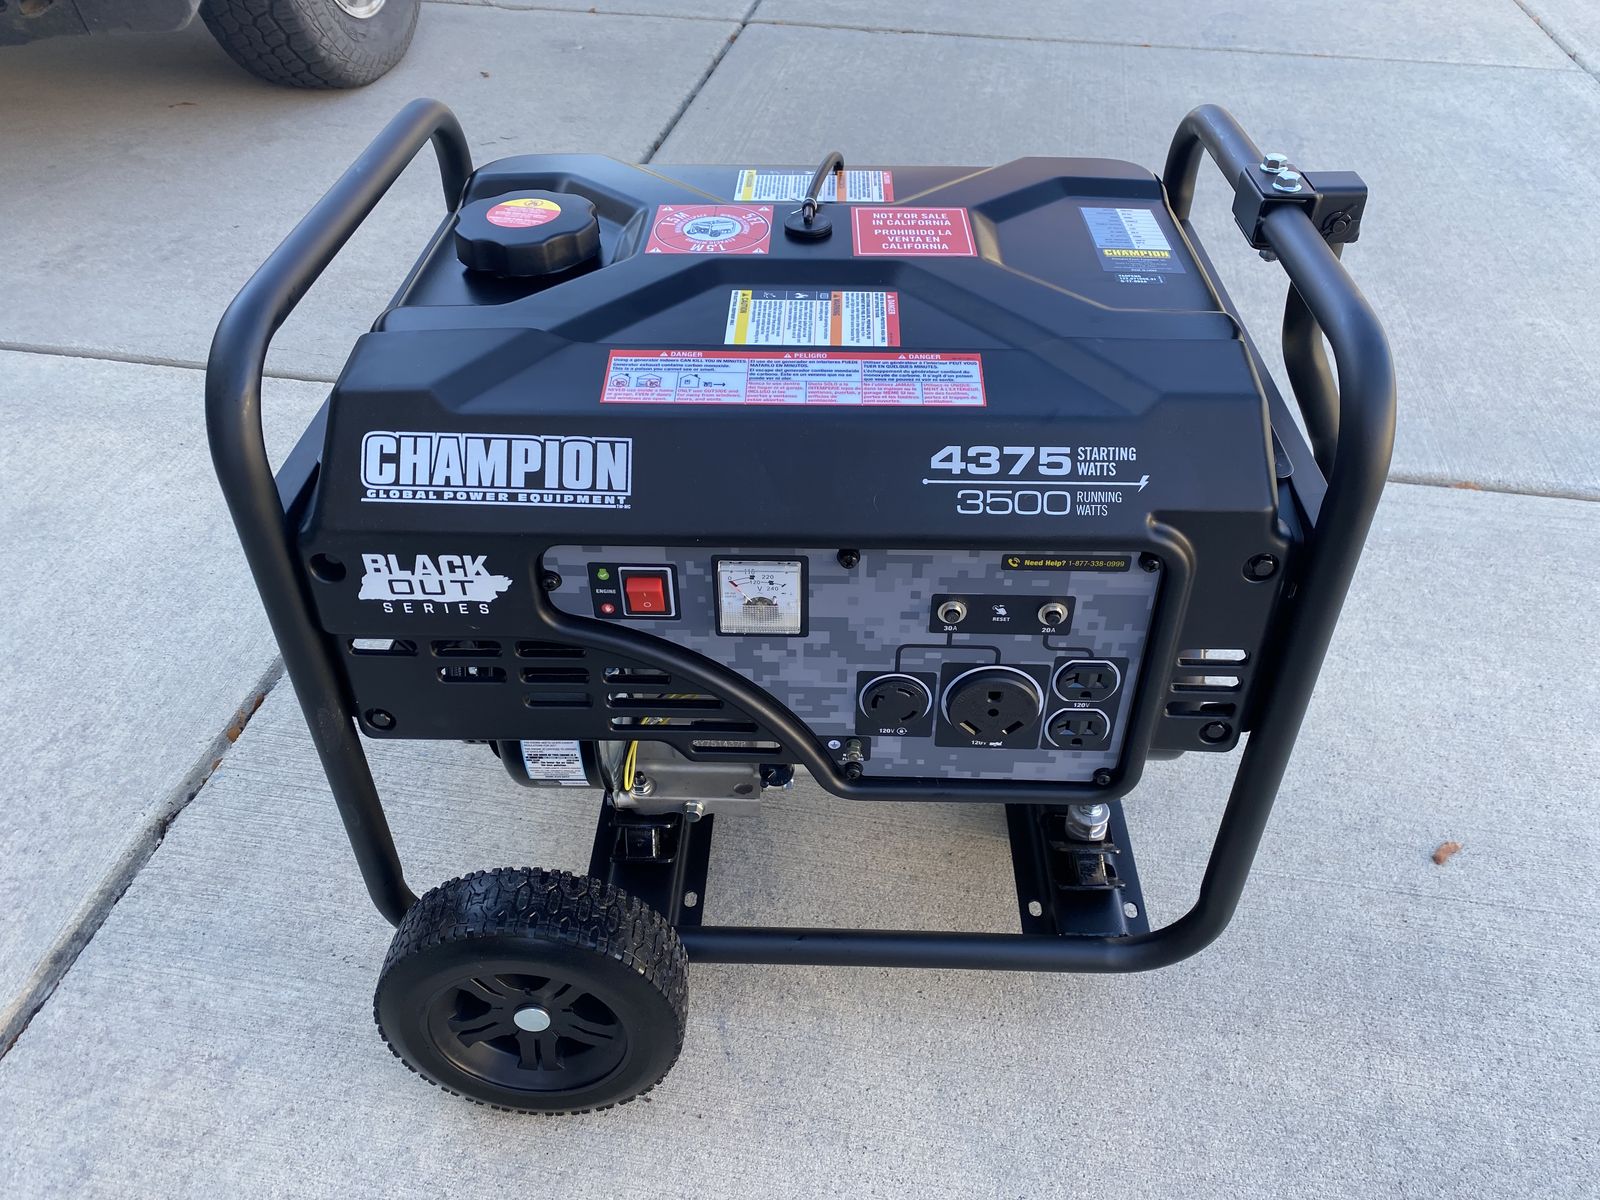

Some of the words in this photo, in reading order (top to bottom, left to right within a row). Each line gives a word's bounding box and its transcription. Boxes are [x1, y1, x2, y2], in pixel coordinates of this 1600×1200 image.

[1103, 249, 1170, 258] CHAMPION
[363, 434, 630, 492] CHAMPION
[930, 446, 1071, 475] 4375
[1077, 446, 1136, 460] STARTING
[1077, 463, 1116, 476] WATTS
[366, 489, 437, 500] GLOBAL
[444, 491, 508, 501] POWER
[518, 492, 626, 504] EQUIPMENT
[956, 490, 1071, 515] 3500
[1077, 492, 1122, 503] RUNNING
[1076, 505, 1108, 516] WATTS
[362, 554, 491, 578] BLACK
[388, 579, 474, 596] OUT
[384, 602, 490, 614] SERIES
